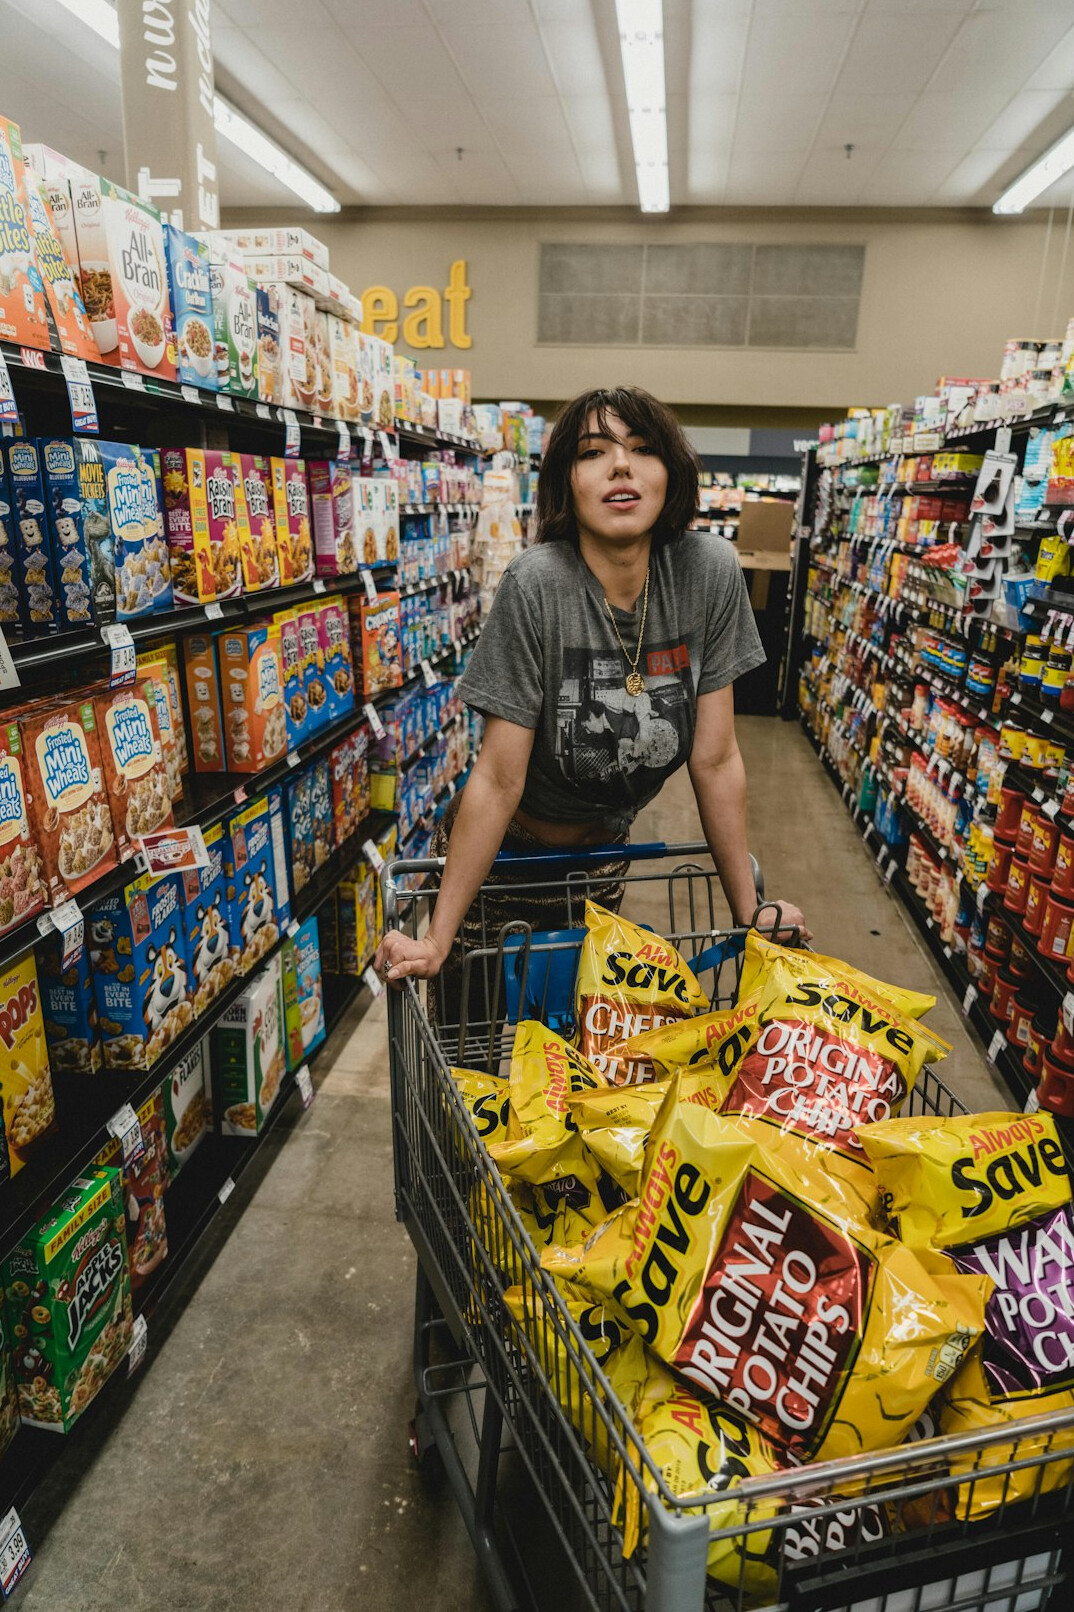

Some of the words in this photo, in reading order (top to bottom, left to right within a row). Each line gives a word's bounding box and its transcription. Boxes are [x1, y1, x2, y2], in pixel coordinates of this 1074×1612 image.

[51, 203, 66, 212] ran
[77, 200, 98, 209] Bran
[0, 227, 30, 254] ites
[122, 250, 159, 291] Bran
[359, 259, 471, 350] eat
[233, 319, 255, 339] Bran
[23, 349, 44, 369] WIC
[13, 453, 34, 465] Mini
[48, 452, 69, 464] Mini
[80, 443, 99, 463] WIN
[79, 463, 105, 483] MOVIE
[80, 483, 106, 499] TICKETS
[114, 485, 141, 512] Mini
[208, 478, 233, 500] Raisin
[168, 517, 190, 525] EVERY
[213, 499, 233, 517] Bran
[168, 523, 192, 534] BITE
[115, 706, 138, 721] Frosted
[46, 731, 73, 752] Frosted
[114, 716, 148, 743] Mini
[45, 742, 83, 773] Mini
[116, 735, 153, 767] Wheats
[0, 773, 18, 798] ni
[47, 760, 91, 800] Wheats
[0, 798, 24, 821] eats
[152, 884, 177, 921] FROSTED
[155, 901, 177, 930] FLAKES
[602, 951, 691, 1004] Save
[51, 995, 75, 1003] EVERY
[51, 1001, 77, 1012] BITE
[105, 991, 130, 1001] EVERY
[105, 998, 133, 1009] BITE
[0, 979, 39, 1052] POPS
[585, 1002, 695, 1042] CHEE
[785, 982, 914, 1056] Save
[180, 1052, 202, 1087] FLAKES
[756, 1023, 903, 1097] ORIGINA
[542, 1042, 570, 1113] Always
[761, 1063, 891, 1123] POTATO
[968, 1118, 1045, 1161] Always
[951, 1137, 1070, 1218] Save
[50, 1209, 87, 1254] FAMILY
[87, 1187, 110, 1219] SIZE
[625, 1139, 678, 1280] Always
[77, 1243, 112, 1291] APPLE
[612, 1162, 711, 1345] Save
[67, 1246, 123, 1351] JACKS
[725, 1249, 817, 1423] POTATO
[775, 1294, 850, 1431] CHIPS
[935, 1365, 948, 1382] 150
[8, 1532, 24, 1561] 3.99
